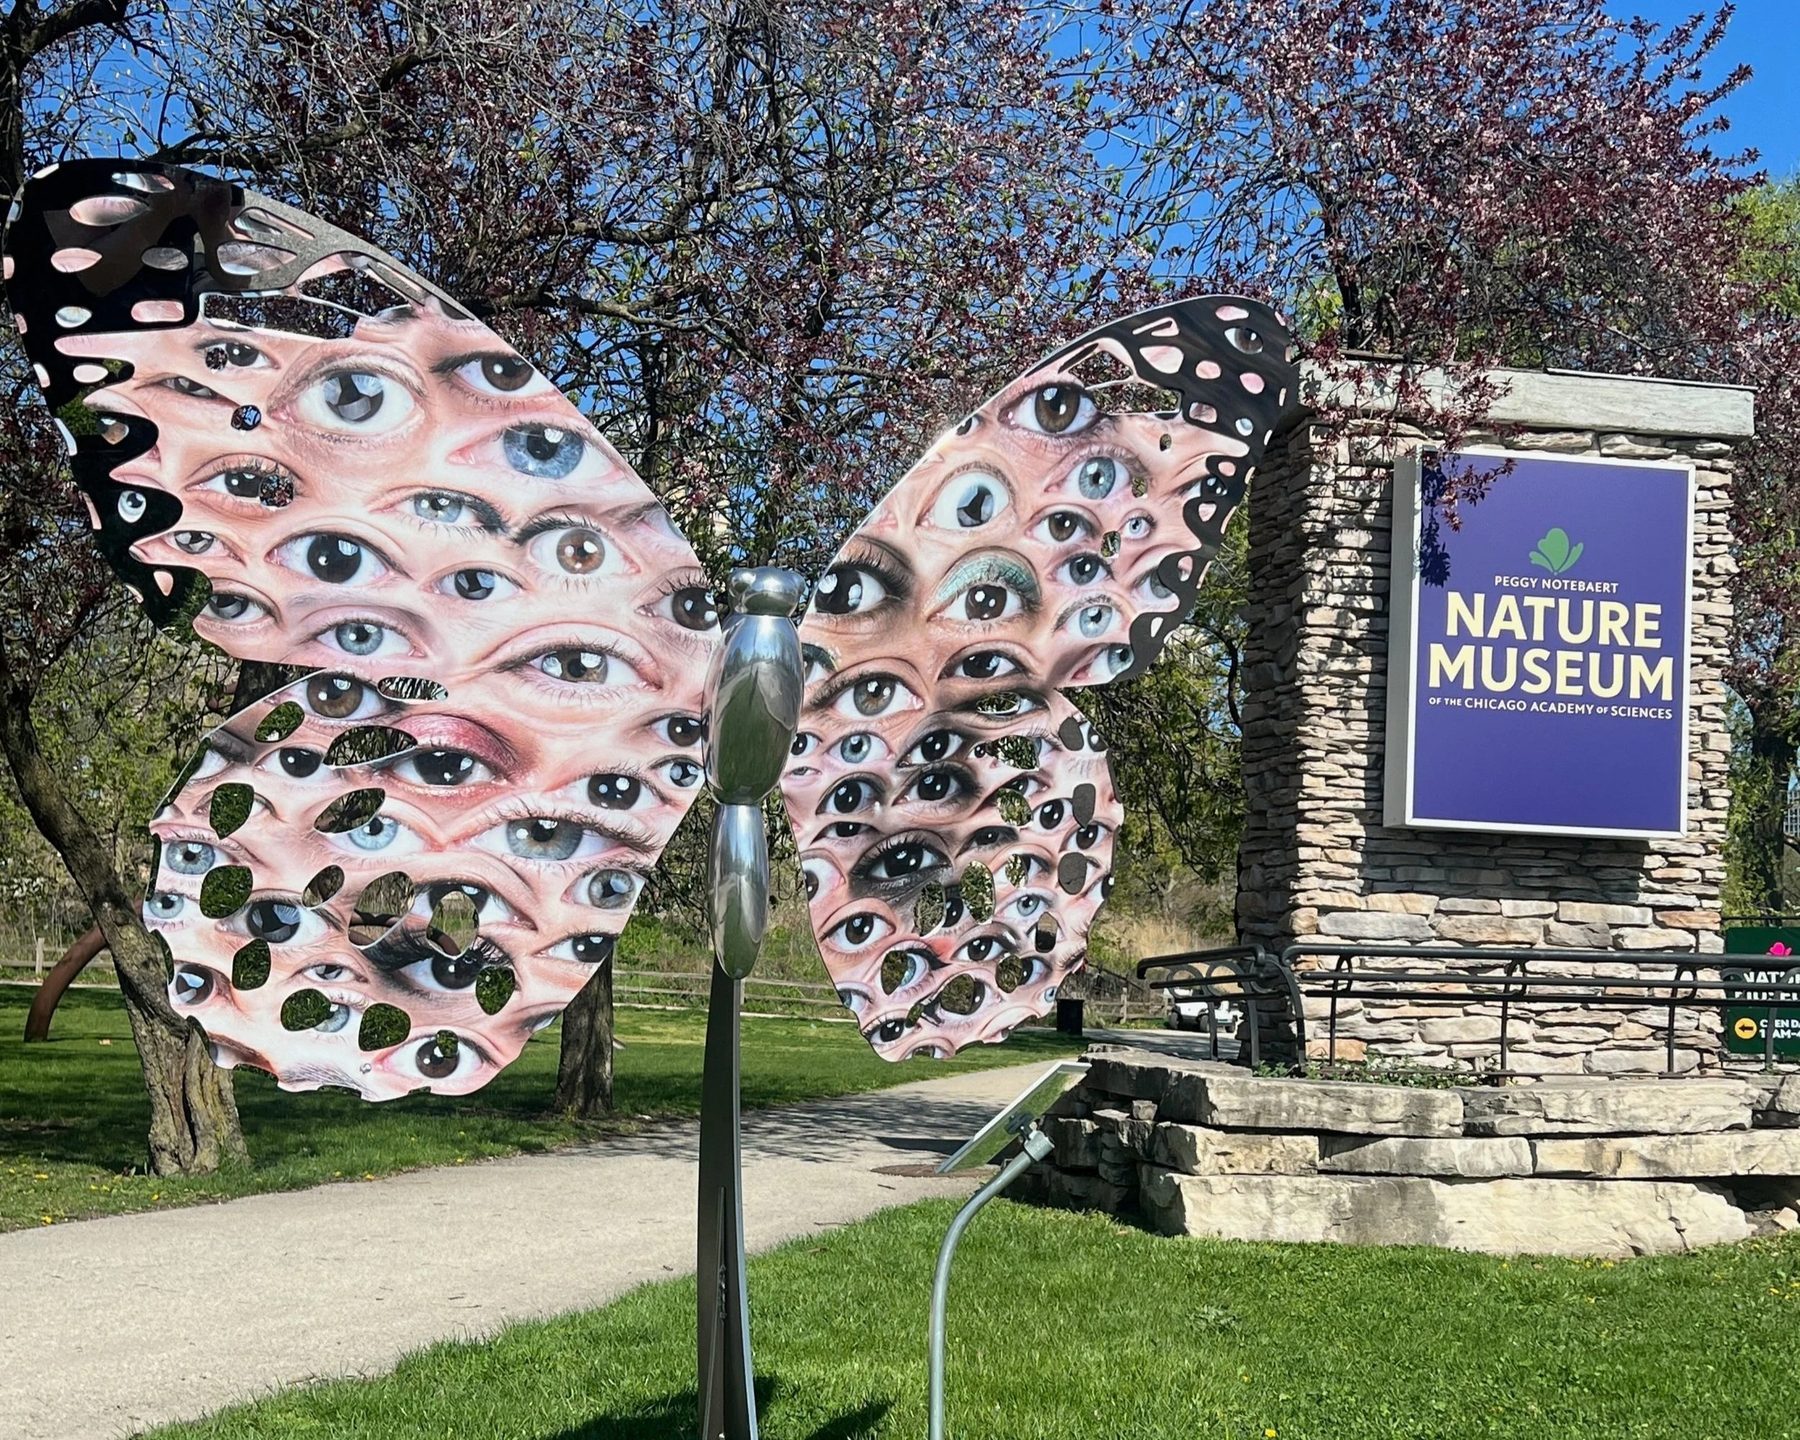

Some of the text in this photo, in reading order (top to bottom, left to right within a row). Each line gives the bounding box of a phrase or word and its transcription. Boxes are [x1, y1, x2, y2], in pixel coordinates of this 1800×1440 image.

[1494, 575, 1619, 594] PEGGY NOTEBAERT
[1446, 591, 1662, 649] NATURE
[1428, 642, 1674, 701] MUSEUM
[1428, 696, 1673, 720] OF THE CHICAGO ACADEMY OF SCIENCES
[1790, 1019, 1800, 1028] D
